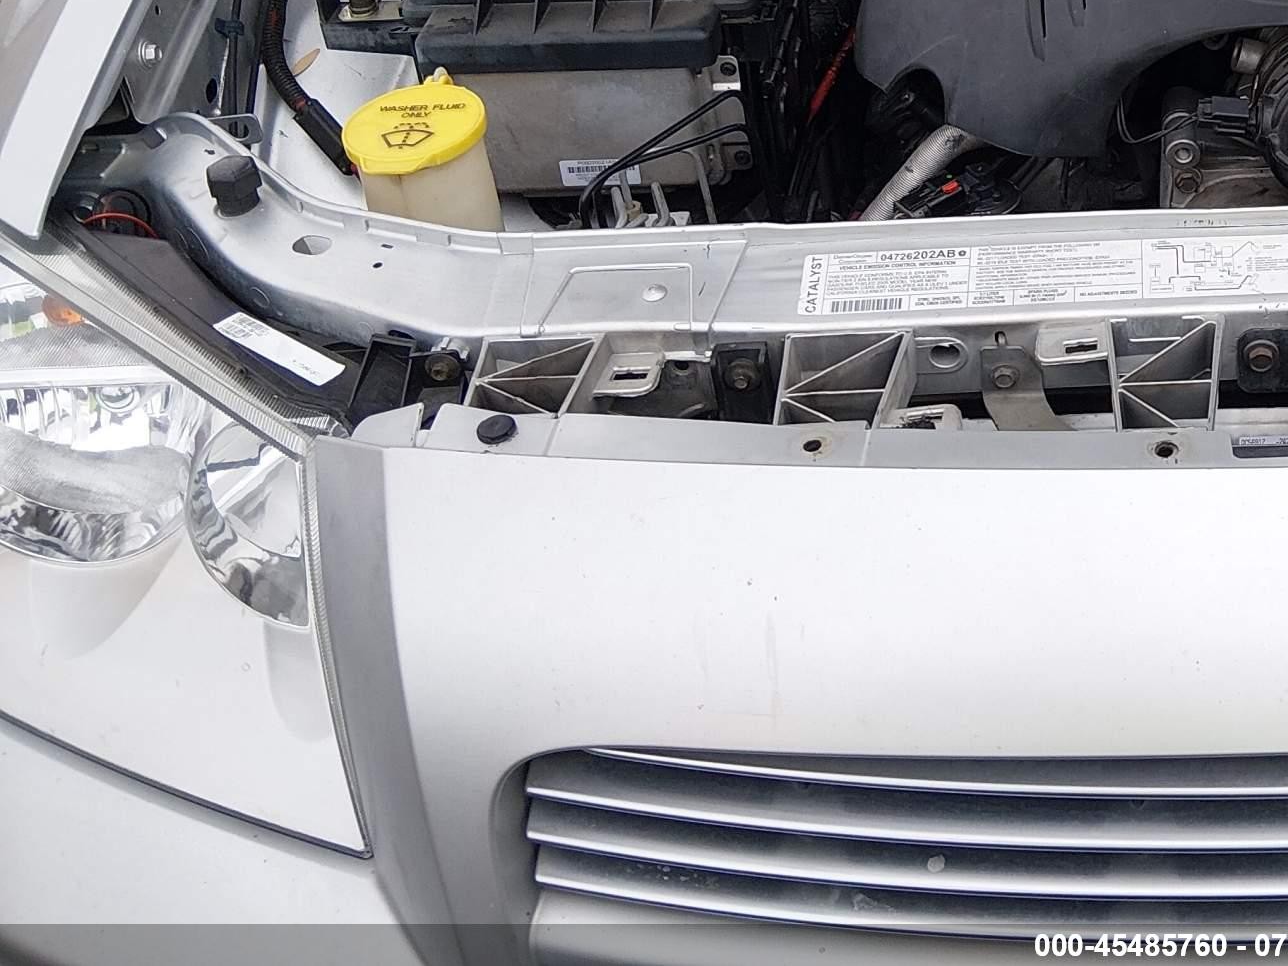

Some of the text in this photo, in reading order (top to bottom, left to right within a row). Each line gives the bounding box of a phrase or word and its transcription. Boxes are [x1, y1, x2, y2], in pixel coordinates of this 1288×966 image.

[380, 102, 466, 112] WASHER FLUID
[401, 111, 432, 119] ONLY
[880, 249, 957, 262] 04726202AB
[805, 256, 824, 314] CATALYST
